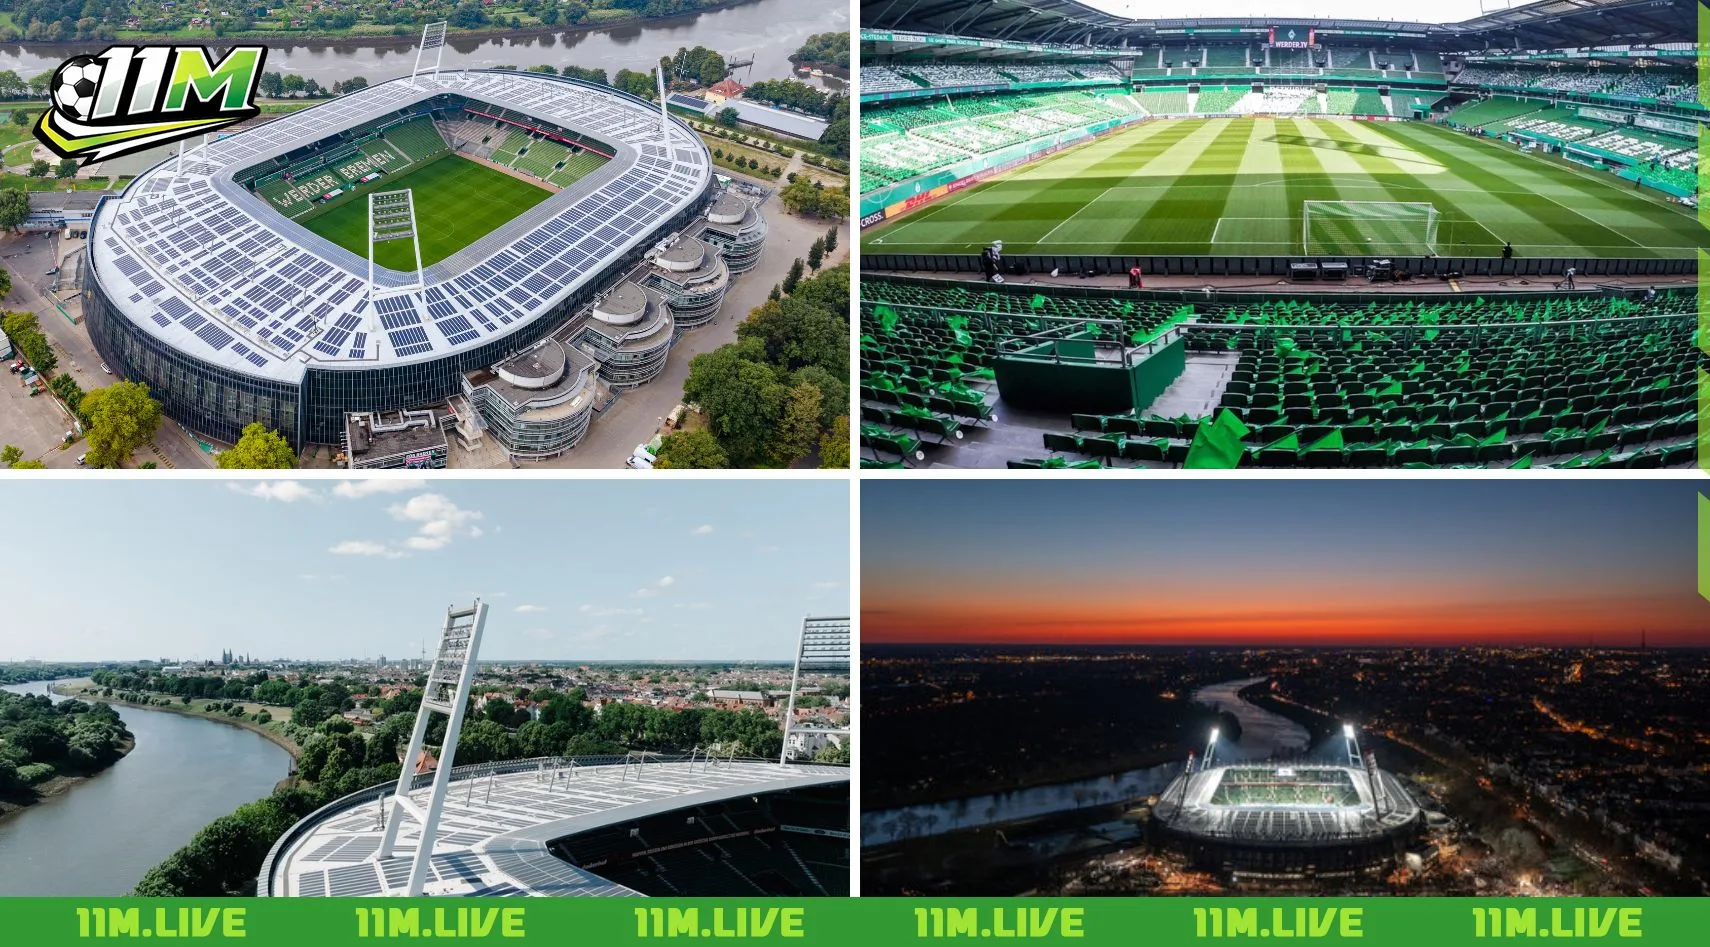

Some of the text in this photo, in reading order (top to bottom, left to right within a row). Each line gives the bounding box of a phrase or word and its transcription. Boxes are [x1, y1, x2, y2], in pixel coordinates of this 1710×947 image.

[1275, 41, 1308, 49] WERDER.TV
[273, 150, 396, 207] WERDER BREMEN
[904, 191, 930, 209] DHL
